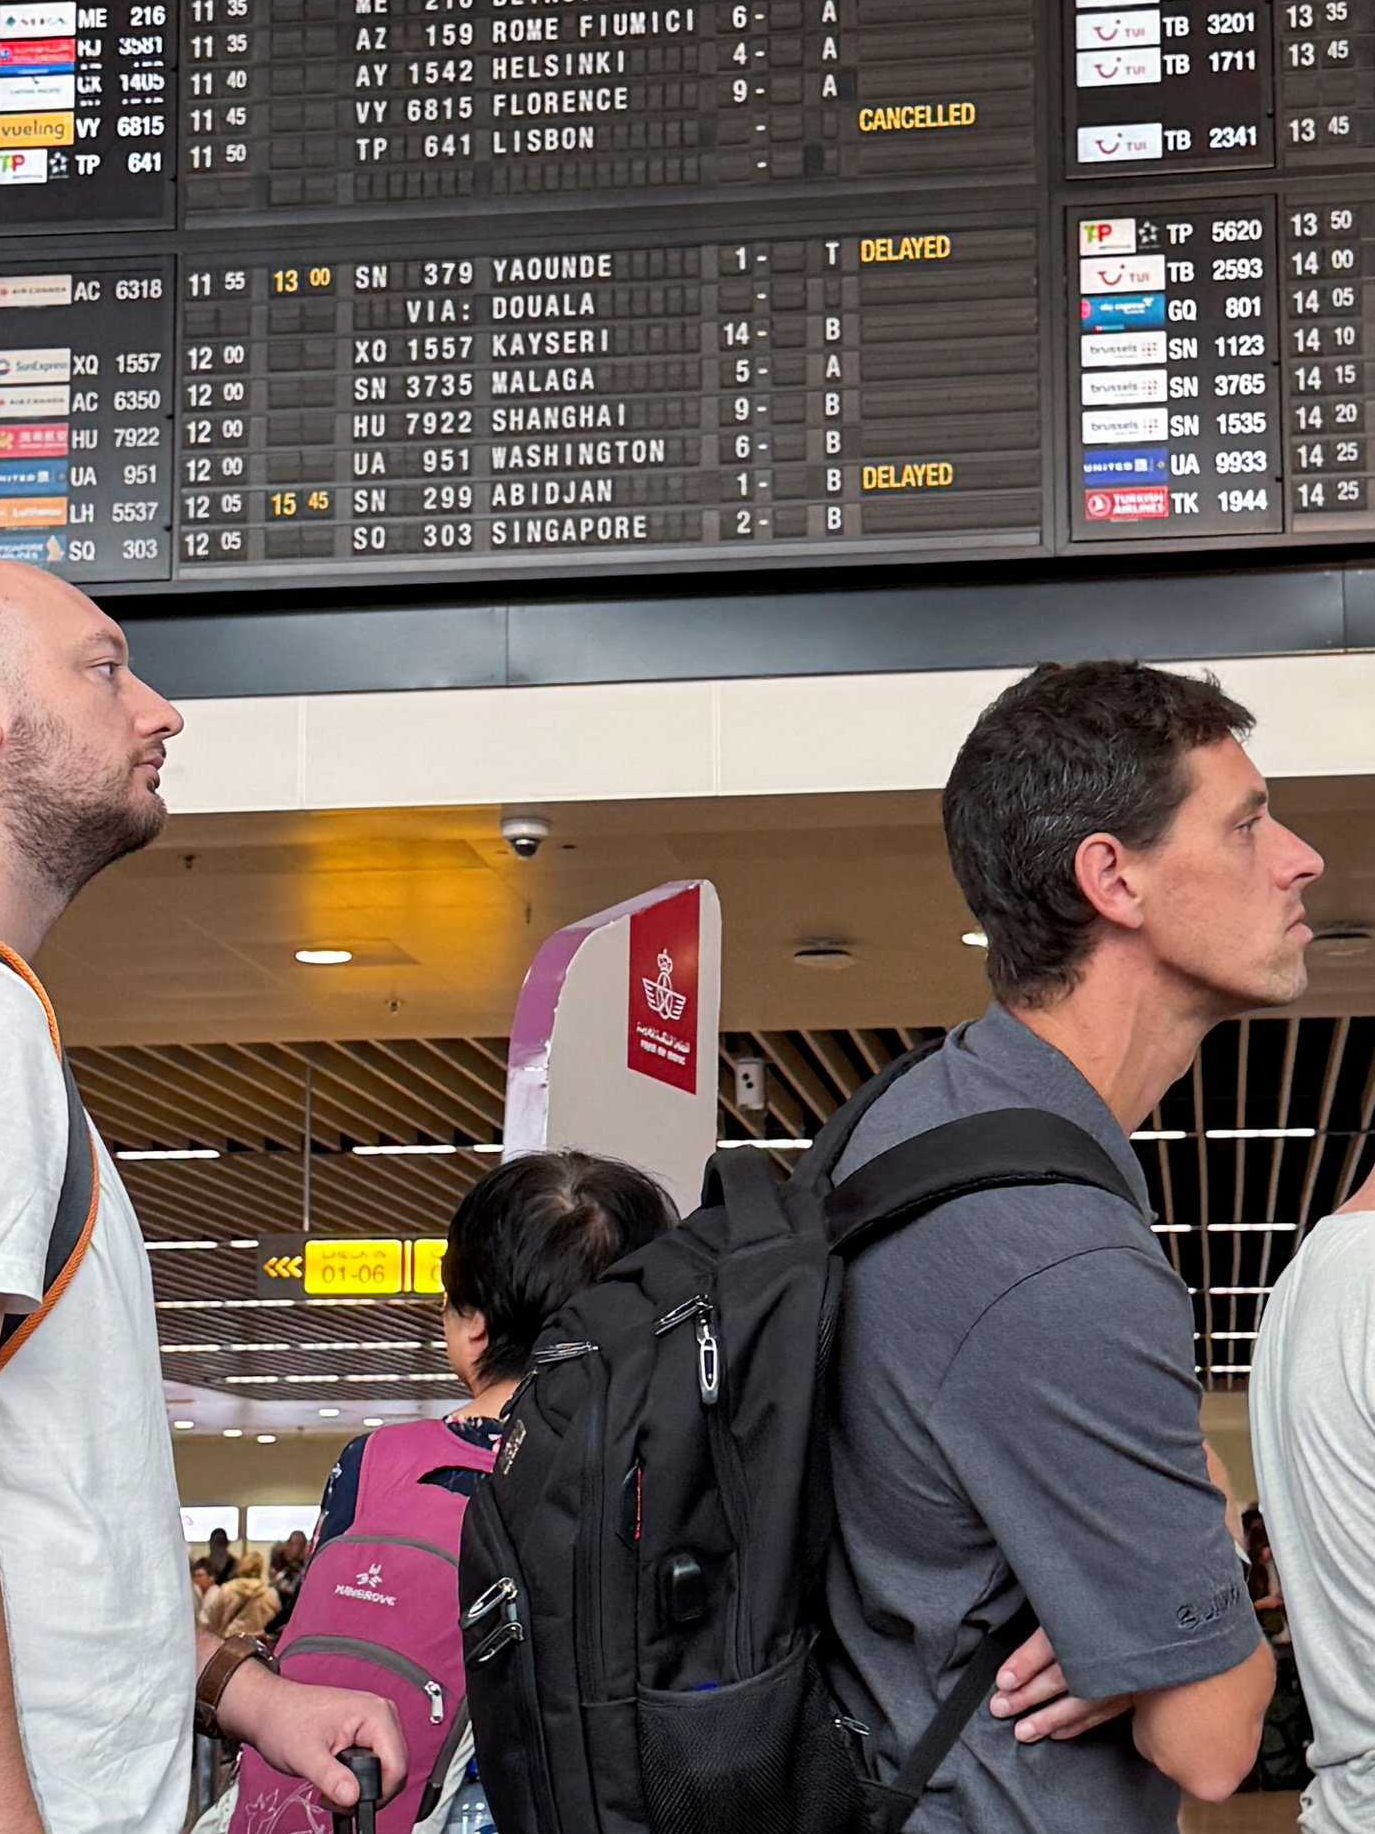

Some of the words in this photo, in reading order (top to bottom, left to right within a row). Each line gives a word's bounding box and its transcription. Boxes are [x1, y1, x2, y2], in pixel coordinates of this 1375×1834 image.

[493, 18, 557, 42] ROME
[581, 9, 693, 37] FIUMICI
[493, 51, 623, 79] HELSINKI
[494, 87, 627, 116] FLORENCE
[494, 127, 593, 153] LISBON
[859, 103, 975, 131] CANCELLED
[494, 255, 611, 281] YAOUNDE
[861, 235, 950, 262] DELAYED
[493, 293, 594, 319] DOUALA
[493, 329, 607, 356] KAYSERI
[493, 404, 624, 431] SHANGHAI
[493, 480, 611, 505] ABIDJAN
[863, 463, 953, 489] DELAYED
[493, 516, 645, 543] SINGAPORE
[322, 1265, 385, 1284] 01-06
